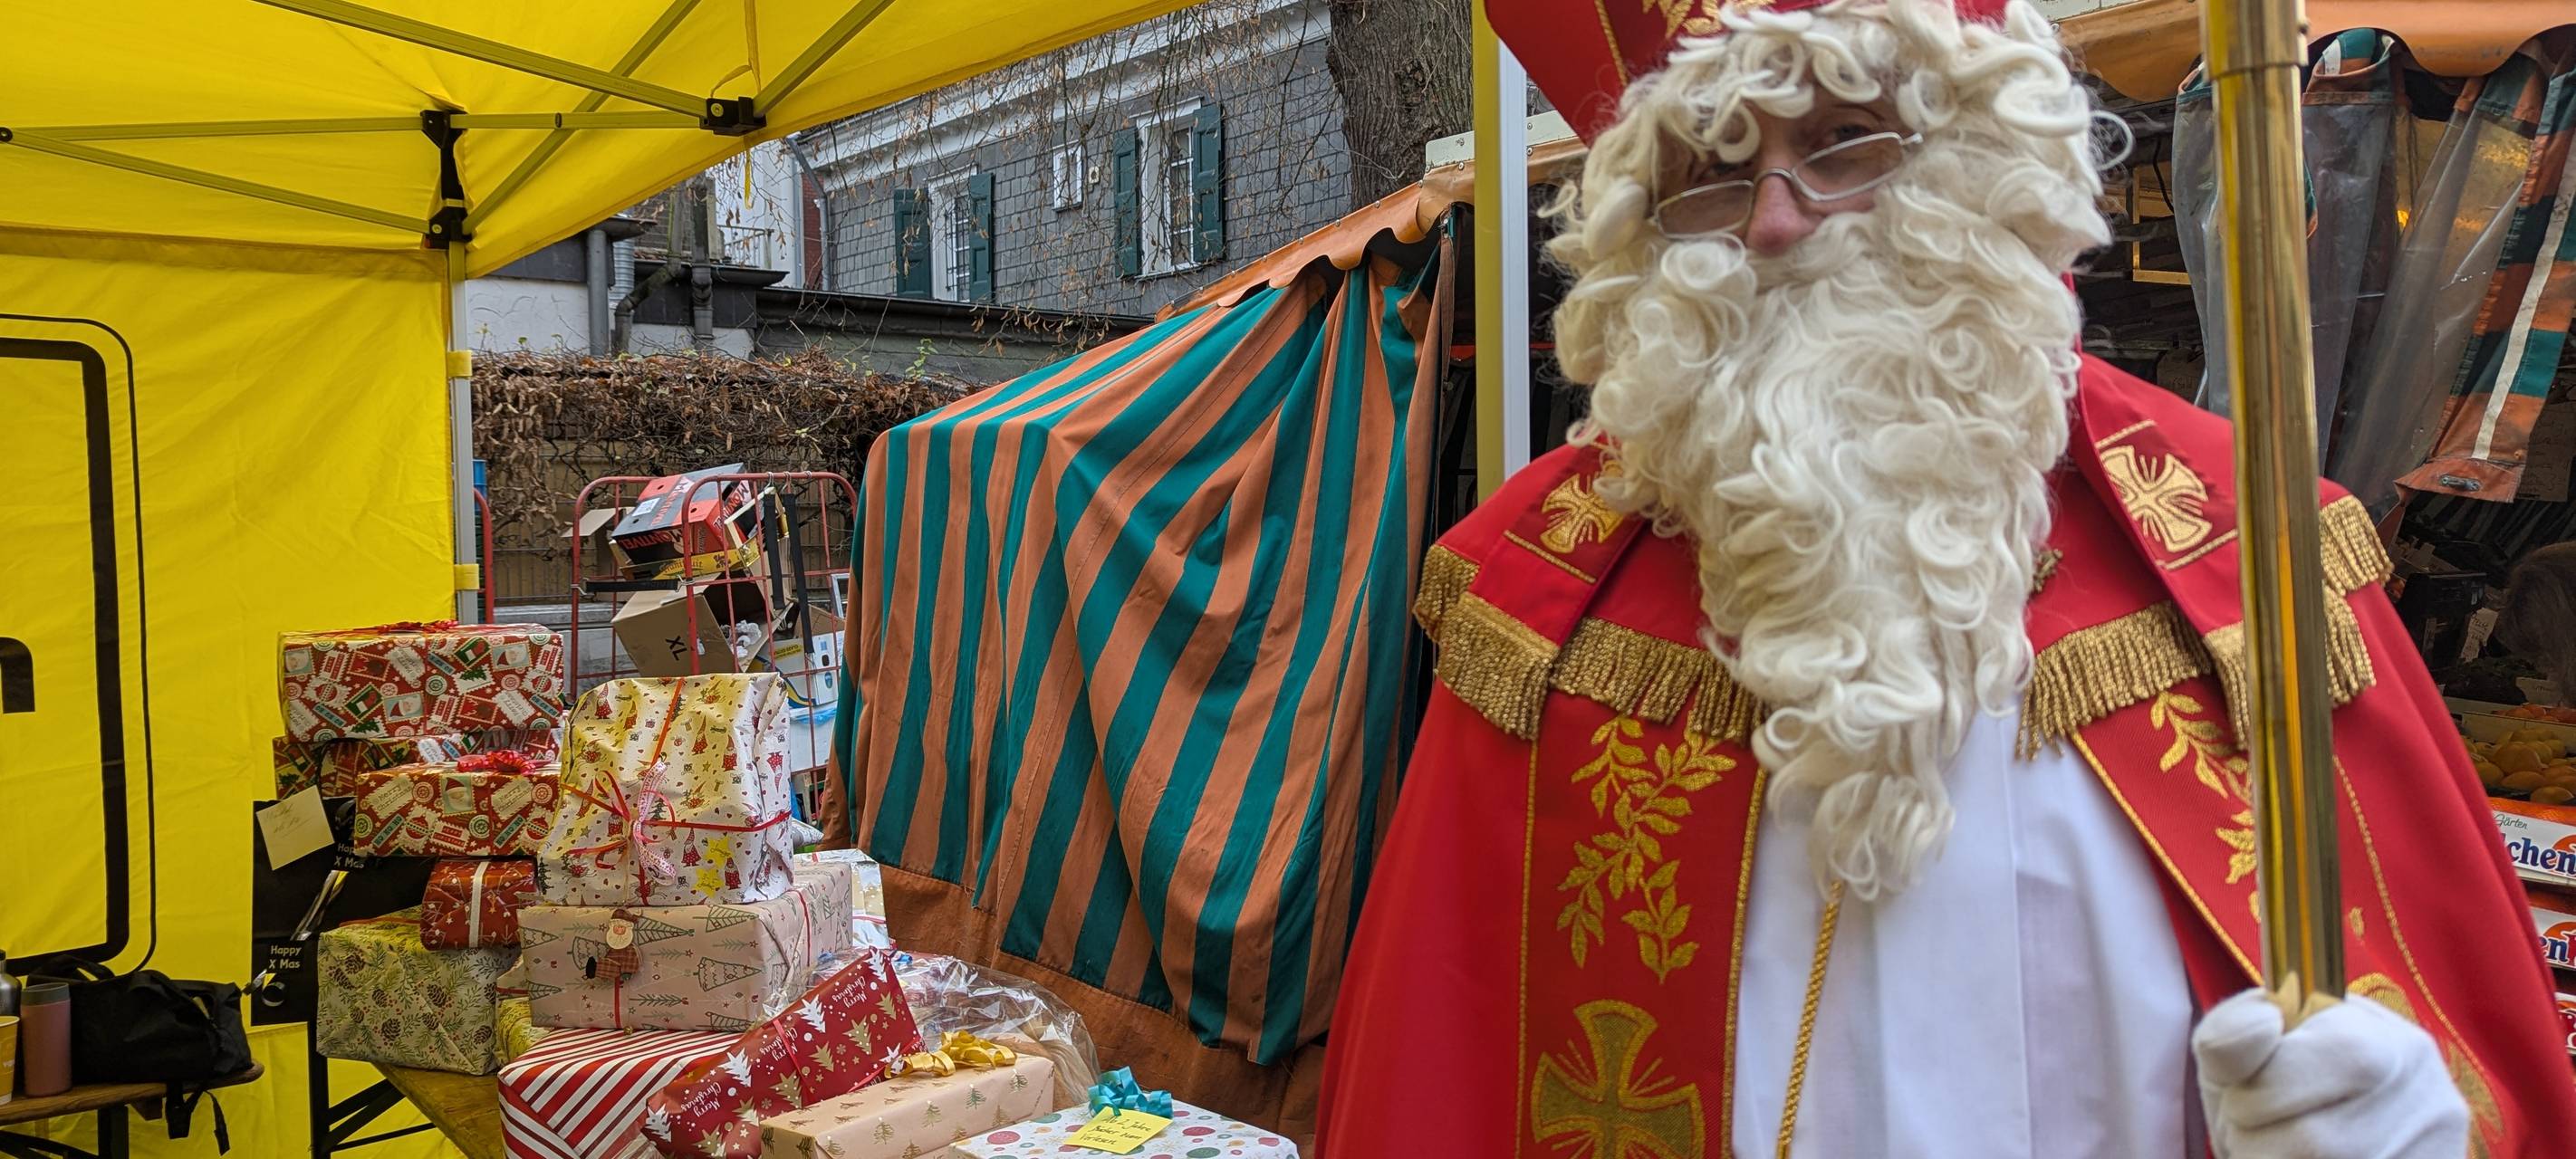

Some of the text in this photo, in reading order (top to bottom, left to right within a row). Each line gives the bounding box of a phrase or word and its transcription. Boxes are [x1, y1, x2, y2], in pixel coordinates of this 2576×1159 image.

[713, 482, 750, 530] MONTIEL
[665, 636, 687, 661] XL
[378, 785, 402, 801] Merry
[338, 843, 355, 854] Hap
[2502, 833, 2576, 875] chen
[271, 945, 302, 957] Happy
[269, 959, 301, 969] X Mas
[831, 975, 866, 1002] Christmas
[843, 991, 867, 1008] Merry
[759, 1027, 798, 1055] Chrstmas
[772, 1042, 798, 1061] Mrry
[680, 1081, 722, 1112] Christmas
[693, 1097, 721, 1117] Merry
[1122, 1121, 1152, 1132] Jahre
